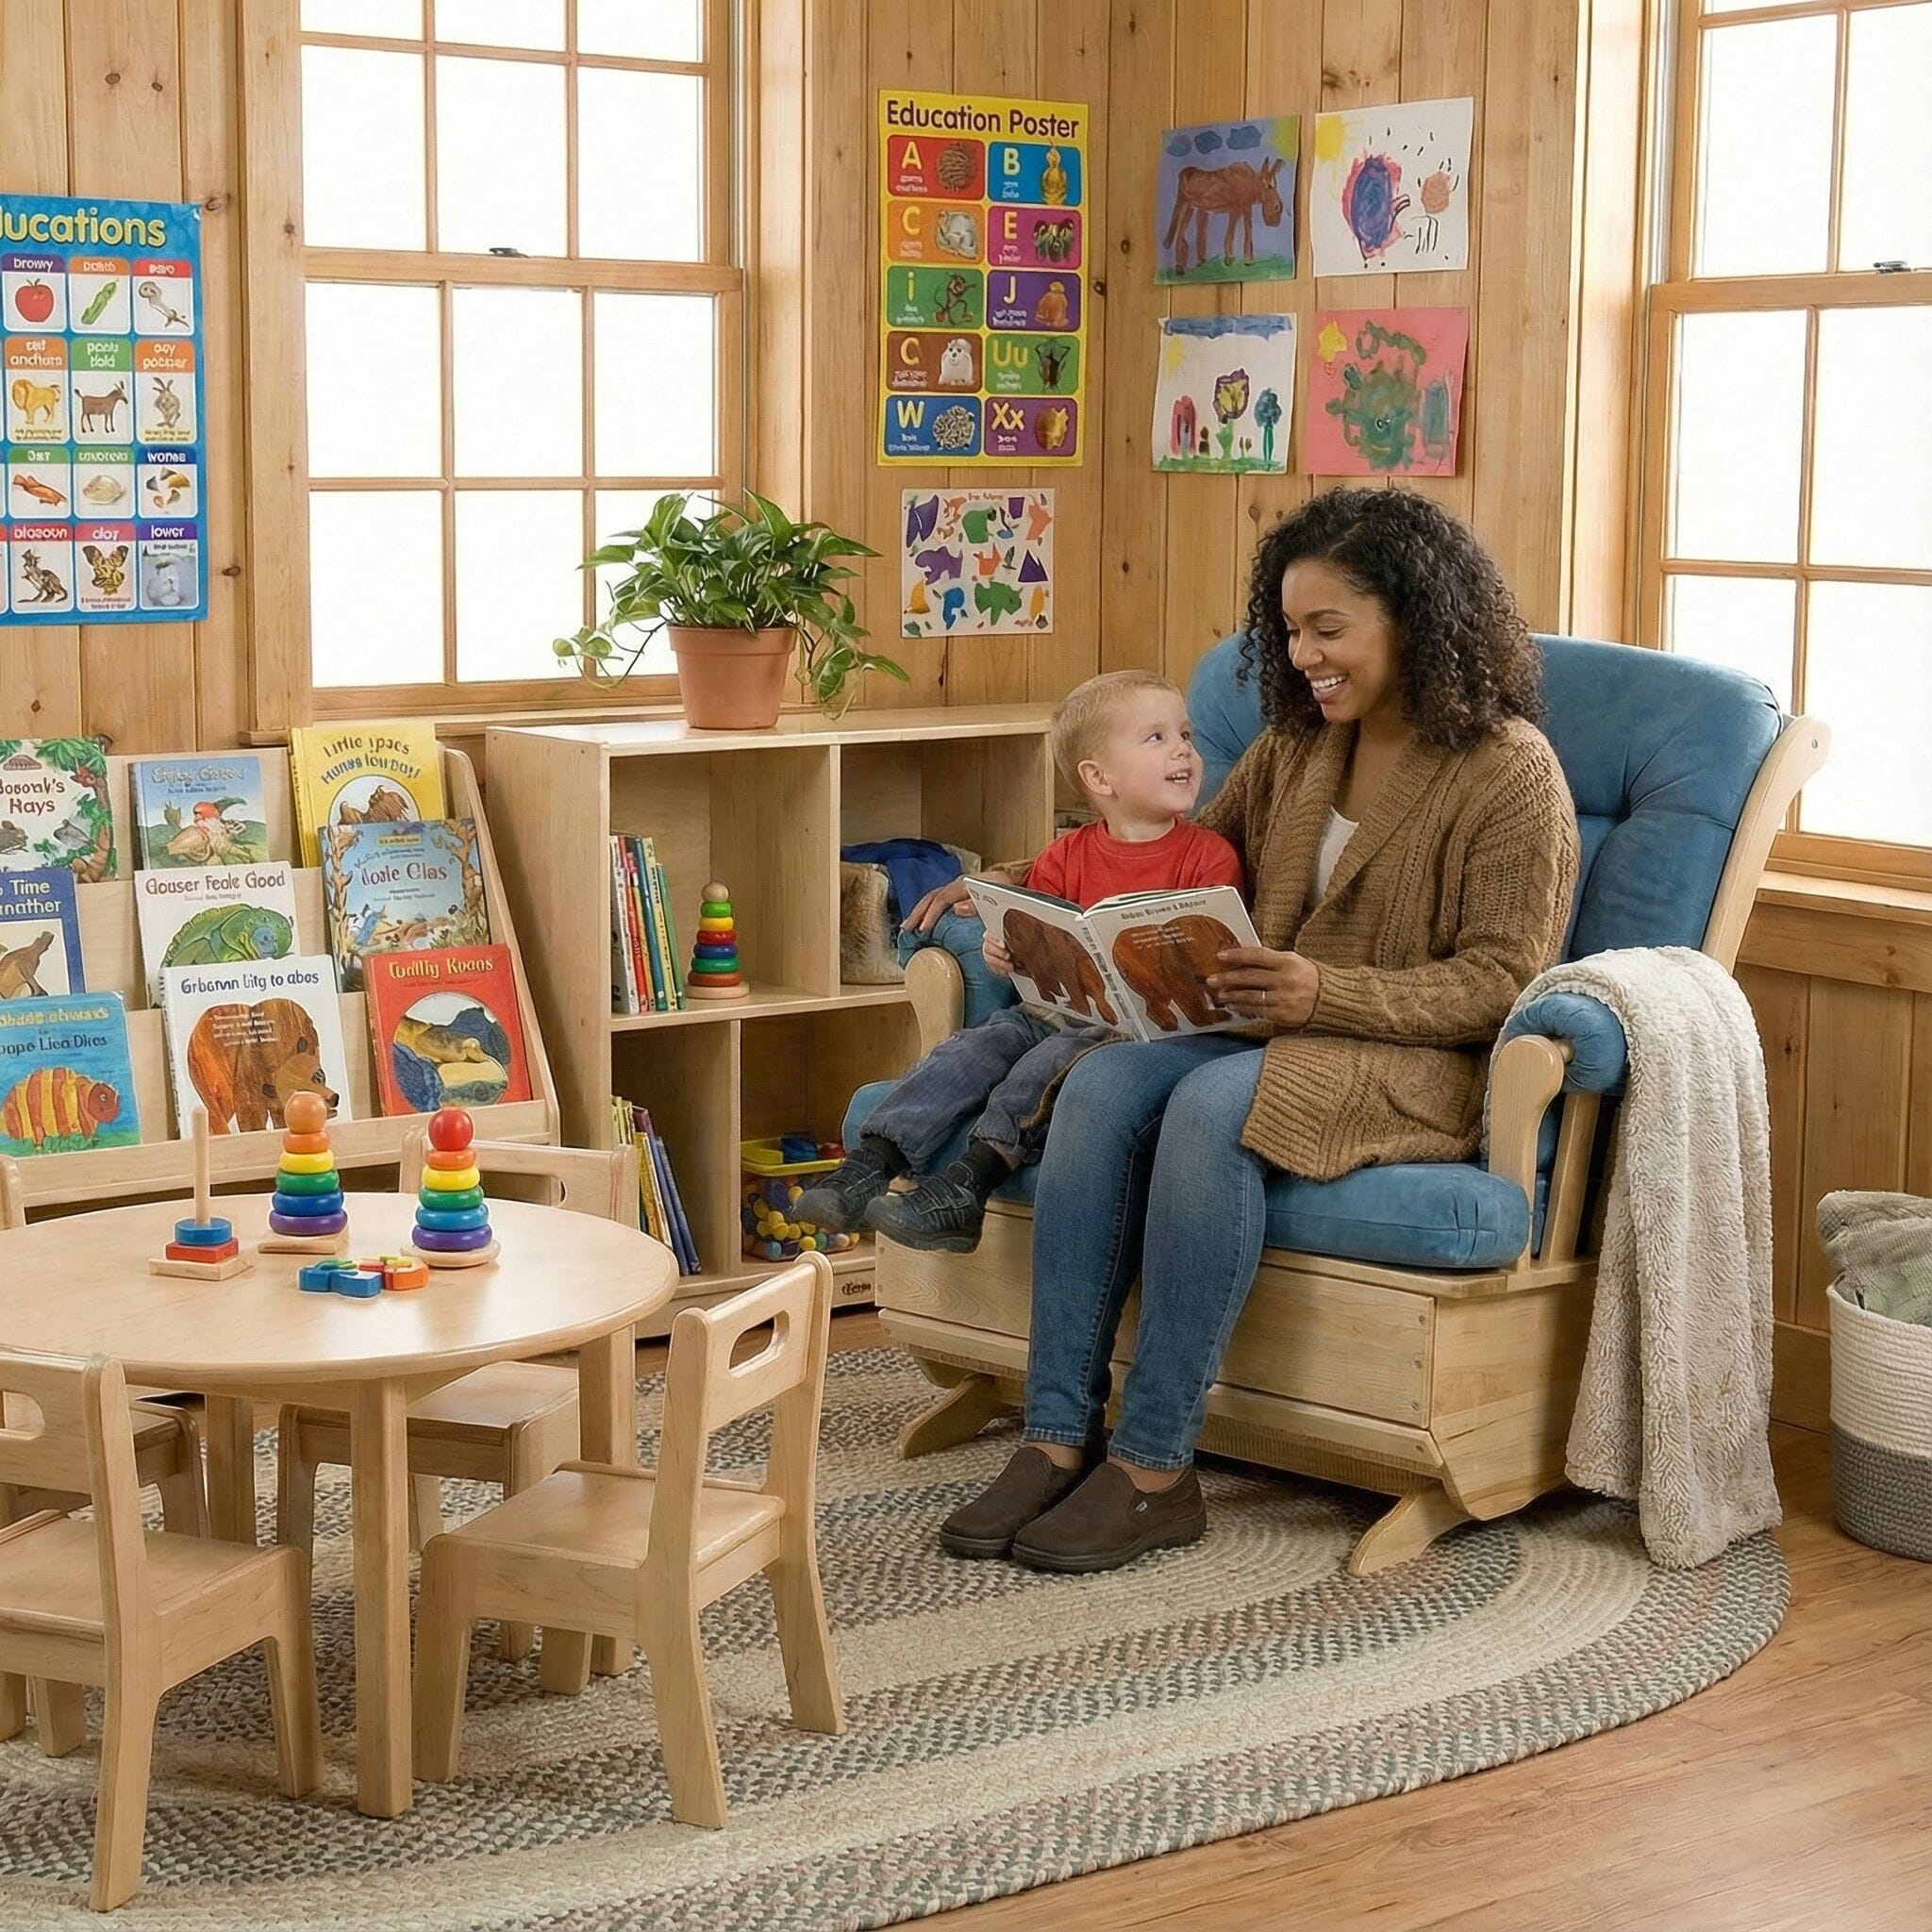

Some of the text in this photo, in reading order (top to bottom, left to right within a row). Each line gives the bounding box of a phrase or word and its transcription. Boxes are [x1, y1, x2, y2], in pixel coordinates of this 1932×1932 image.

[887, 99, 1080, 139] Education Poster
[901, 141, 923, 171] A
[1003, 147, 1021, 176] B
[0, 205, 167, 247] ucations
[902, 206, 921, 236] C
[1004, 211, 1018, 240] E
[1003, 275, 1017, 304] J
[900, 337, 921, 366] C
[992, 339, 1028, 369] Uu
[896, 400, 924, 428] W
[991, 402, 1025, 431] Xx
[8, 878, 52, 895] Time
[245, 870, 286, 889] Good
[270, 974, 284, 988] to
